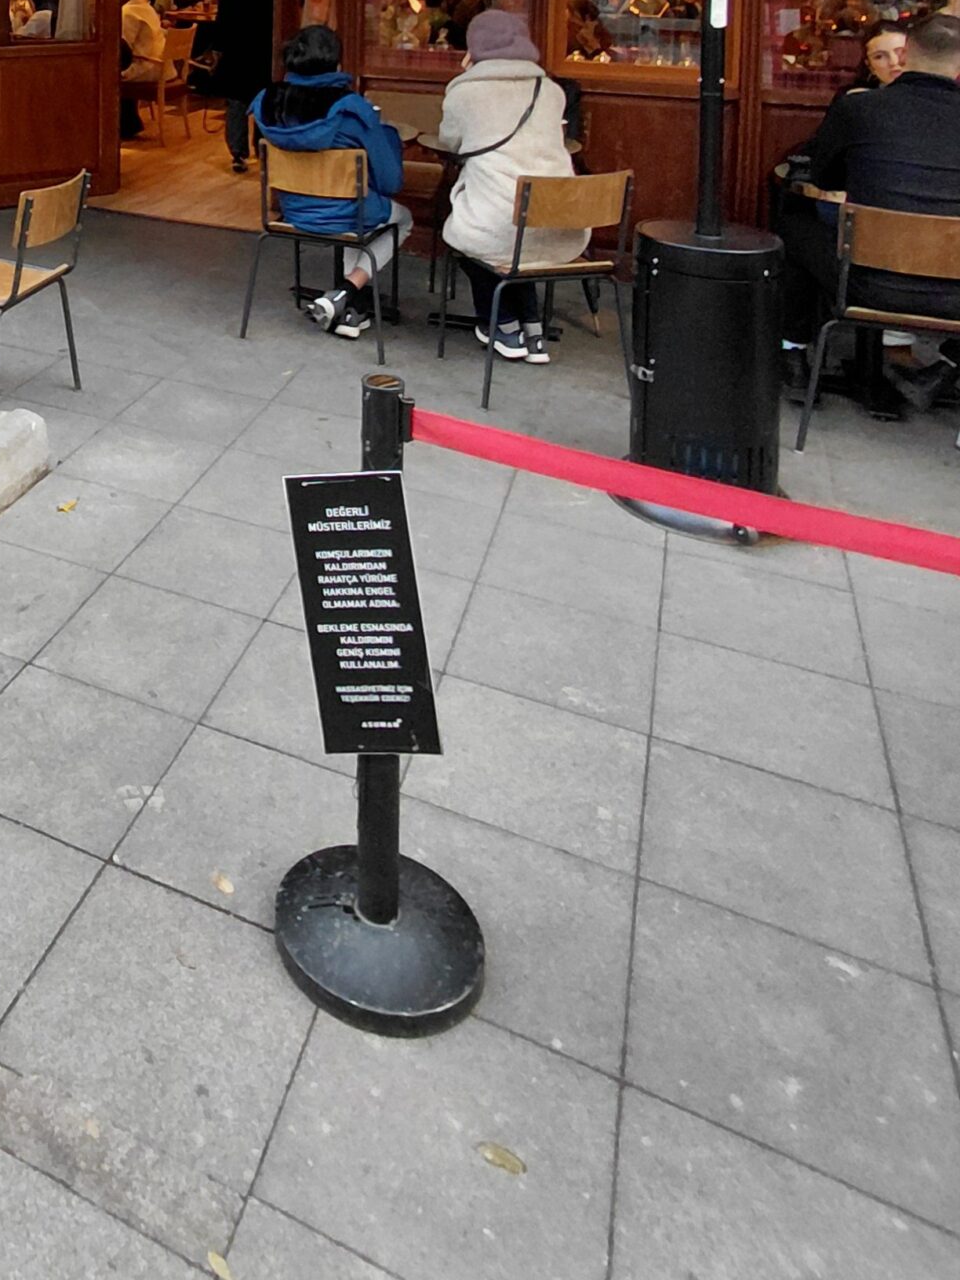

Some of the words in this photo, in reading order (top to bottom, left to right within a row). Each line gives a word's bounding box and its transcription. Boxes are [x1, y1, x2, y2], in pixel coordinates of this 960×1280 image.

[325, 505, 369, 517] DEĞERLİ
[317, 574, 358, 585] RAHATÇA
[359, 573, 398, 583] YÜRÜME
[365, 586, 396, 596] ENGEL
[322, 600, 367, 609] OLMAMAK
